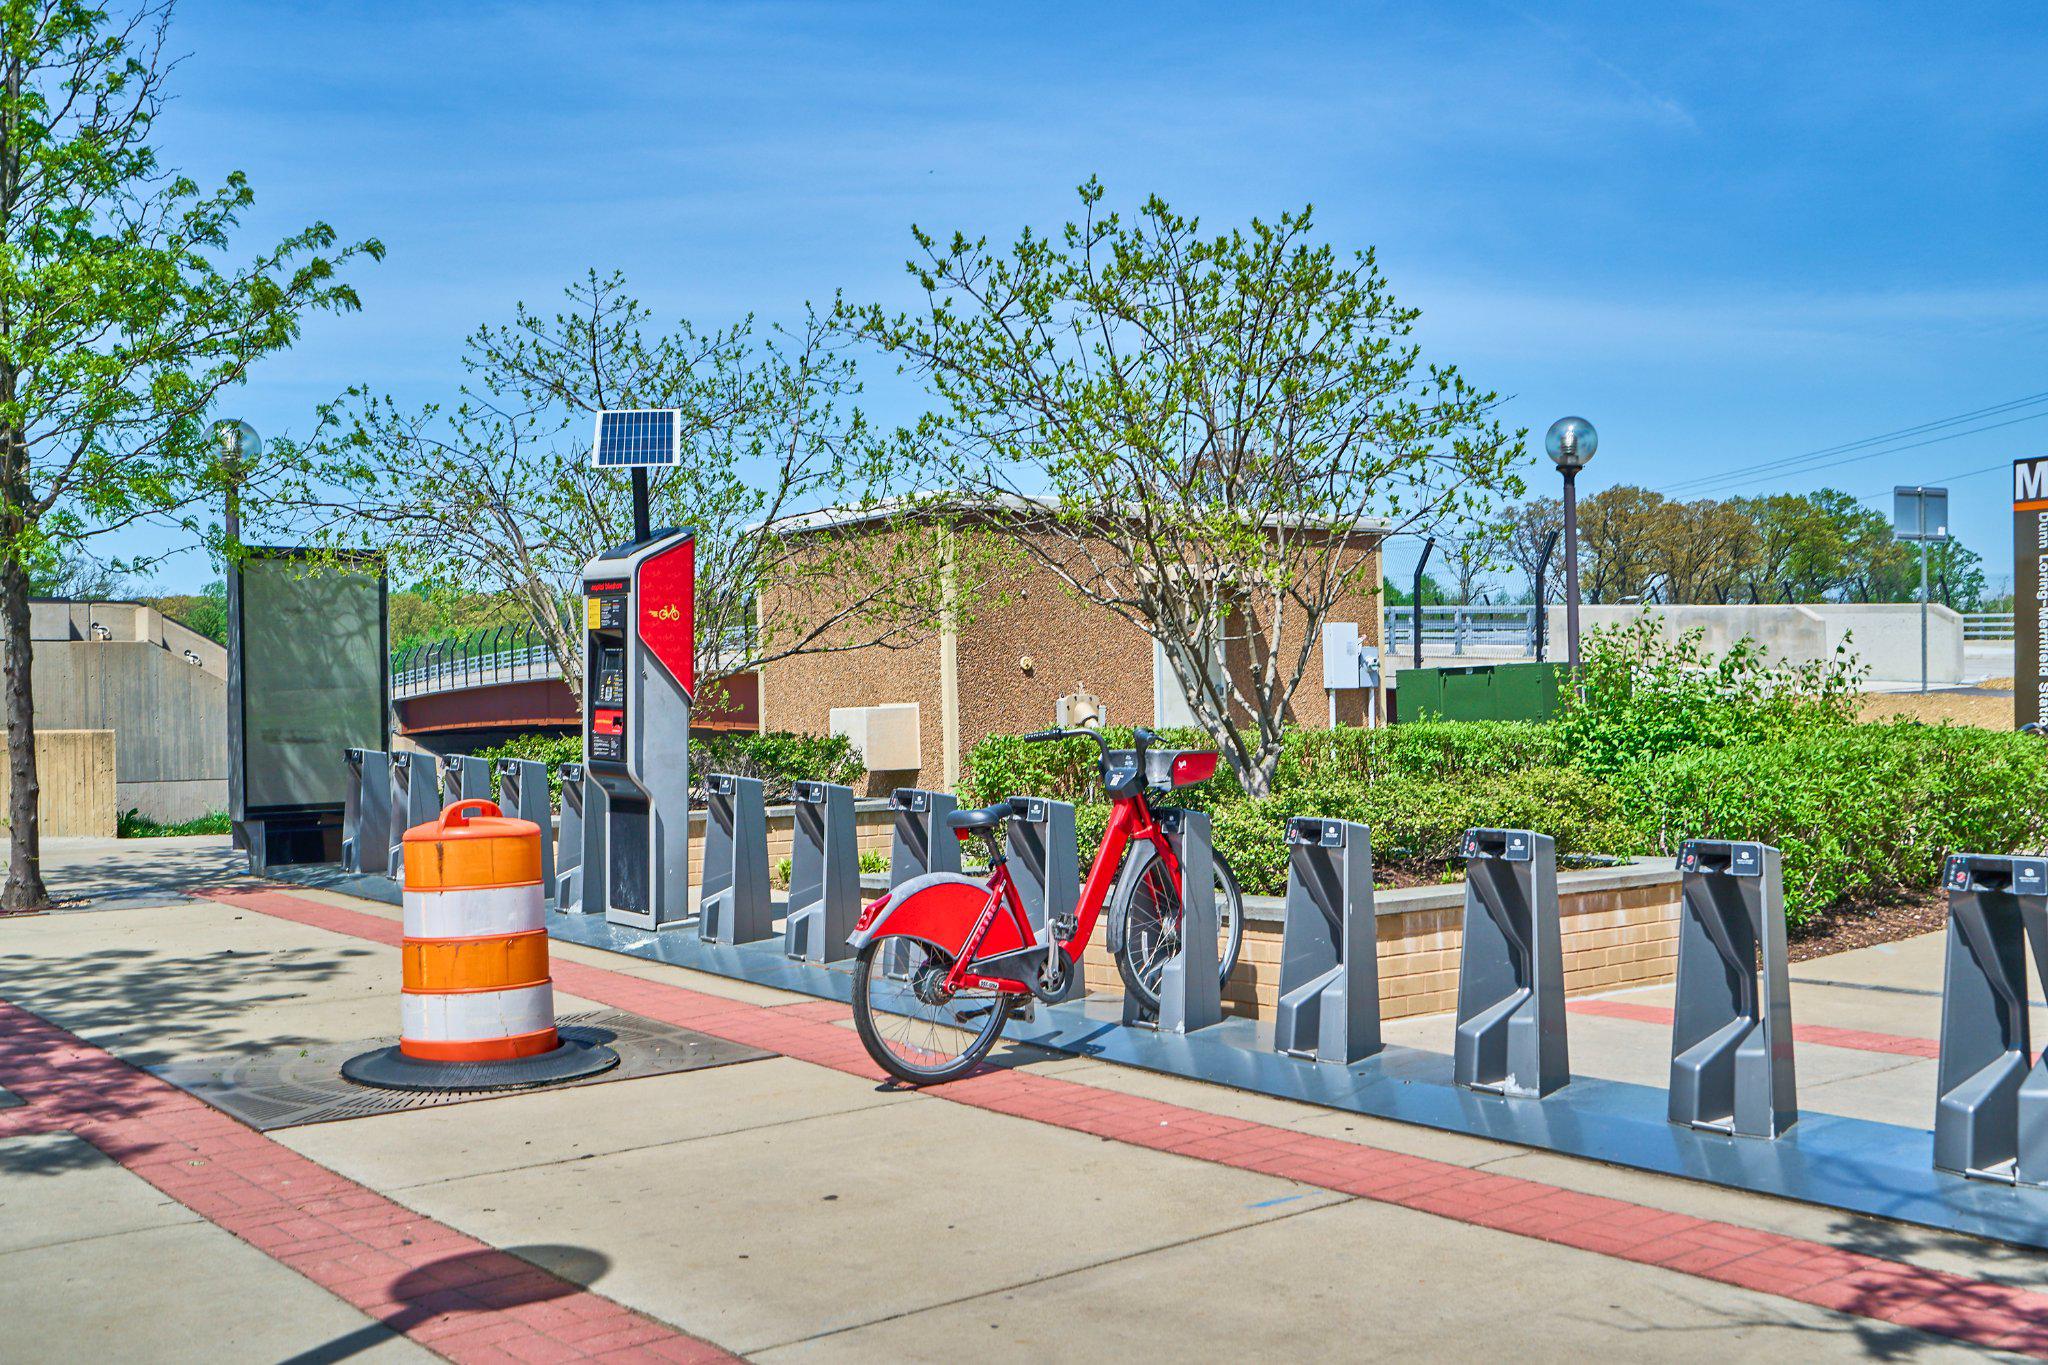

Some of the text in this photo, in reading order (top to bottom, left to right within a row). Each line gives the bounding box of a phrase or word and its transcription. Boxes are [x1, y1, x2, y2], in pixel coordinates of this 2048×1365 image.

[2015, 461, 2048, 500] M
[2036, 512, 2048, 727] Dunn Loring-Merrifield Statio
